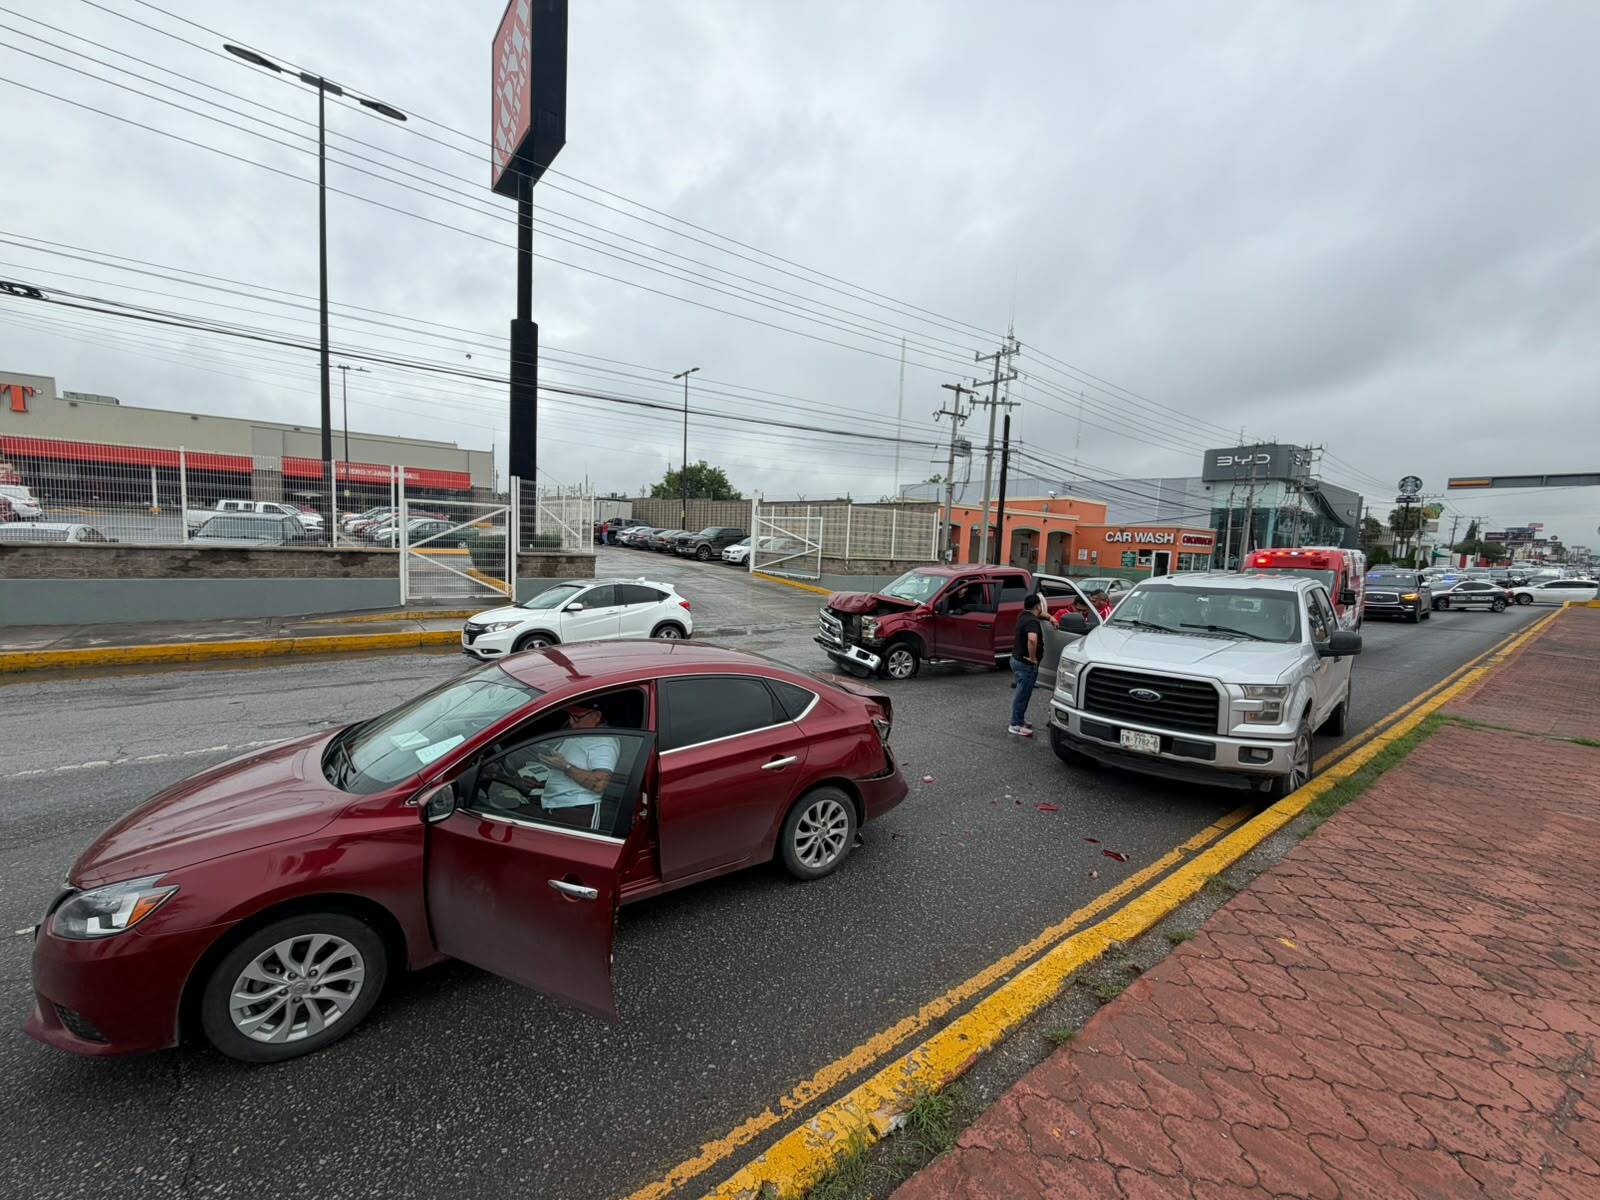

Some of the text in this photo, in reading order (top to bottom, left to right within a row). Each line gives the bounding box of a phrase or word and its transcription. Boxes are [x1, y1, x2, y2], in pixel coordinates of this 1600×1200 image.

[1216, 453, 1270, 466] BYD
[1105, 531, 1132, 543] CAR
[1134, 532, 1175, 544] WASH
